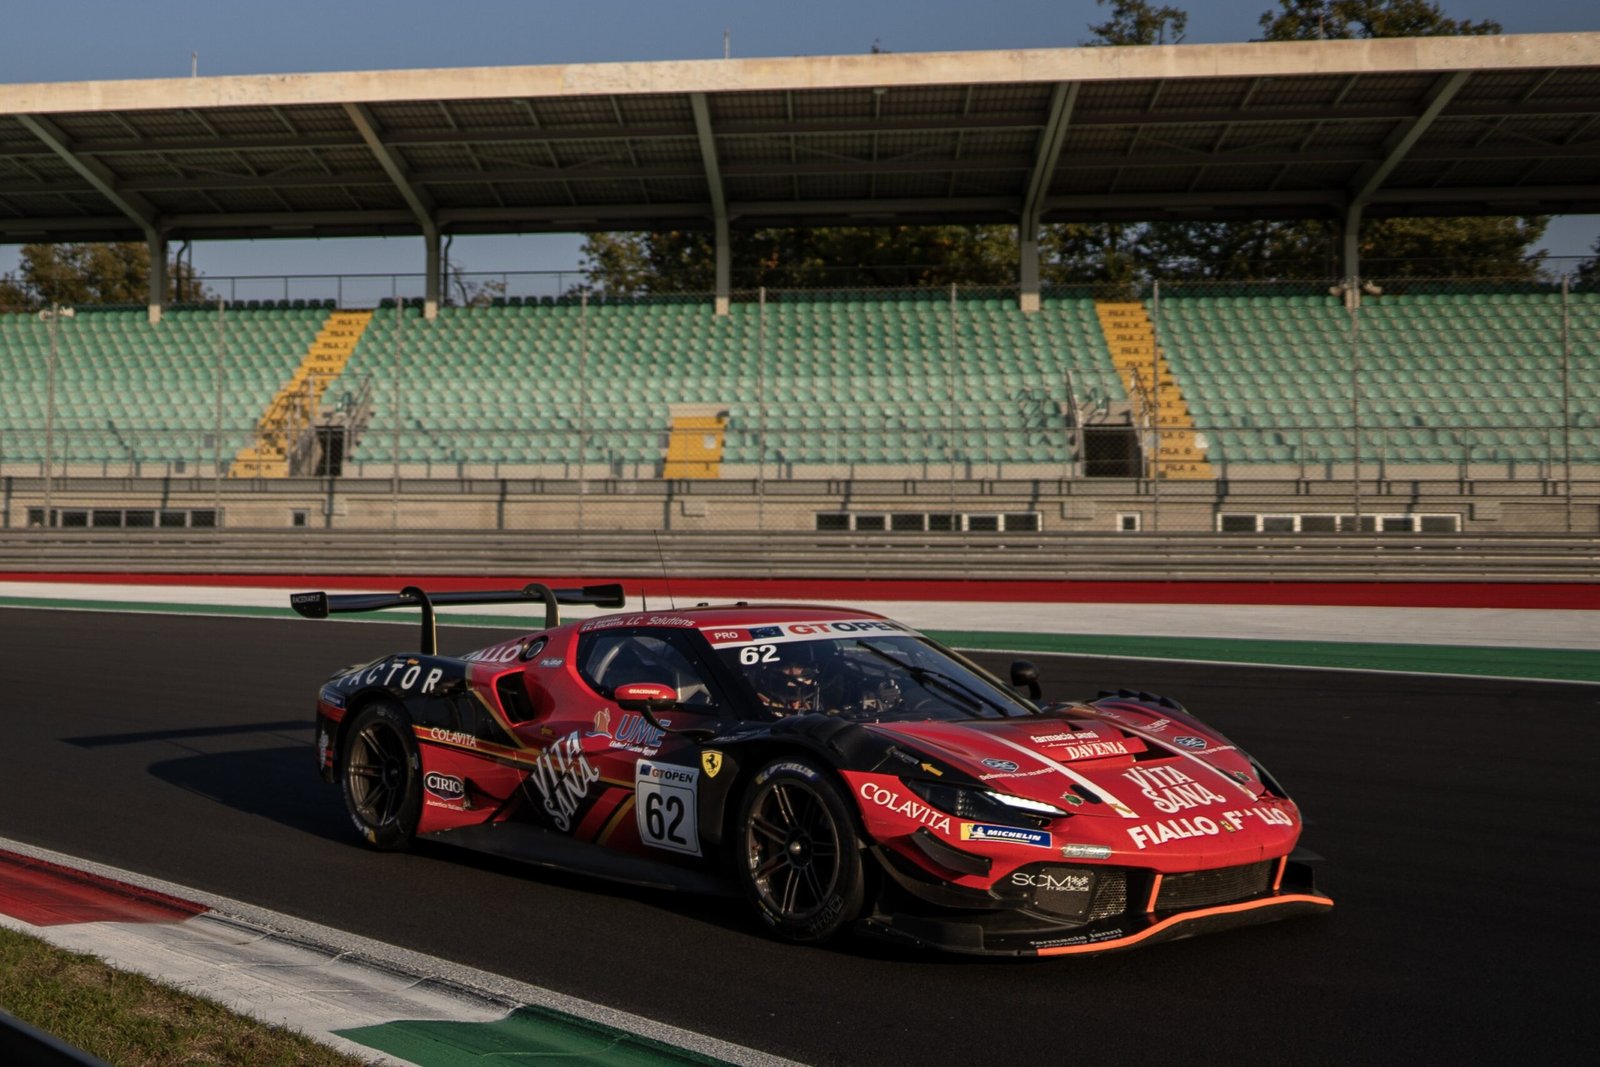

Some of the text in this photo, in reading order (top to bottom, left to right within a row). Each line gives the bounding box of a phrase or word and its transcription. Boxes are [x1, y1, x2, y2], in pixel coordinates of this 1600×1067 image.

[626, 617, 644, 626] LC
[647, 617, 696, 628] Solutions
[714, 632, 739, 641] PRO
[740, 645, 781, 665] 62
[431, 728, 476, 747] COLAVITA
[615, 714, 671, 748] UME
[1030, 732, 1075, 743] farmacia
[1066, 742, 1128, 760] DAVENIA
[427, 776, 460, 793] CIRIO
[544, 754, 600, 832] SANA
[1141, 782, 1227, 814] SANA
[860, 783, 951, 835] COLAVITA
[646, 792, 687, 845] 62
[986, 829, 1043, 842] MICHELIN
[1126, 816, 1219, 850] FIALLO
[1011, 873, 1072, 891] SCM
[1029, 935, 1088, 946] farmacia
